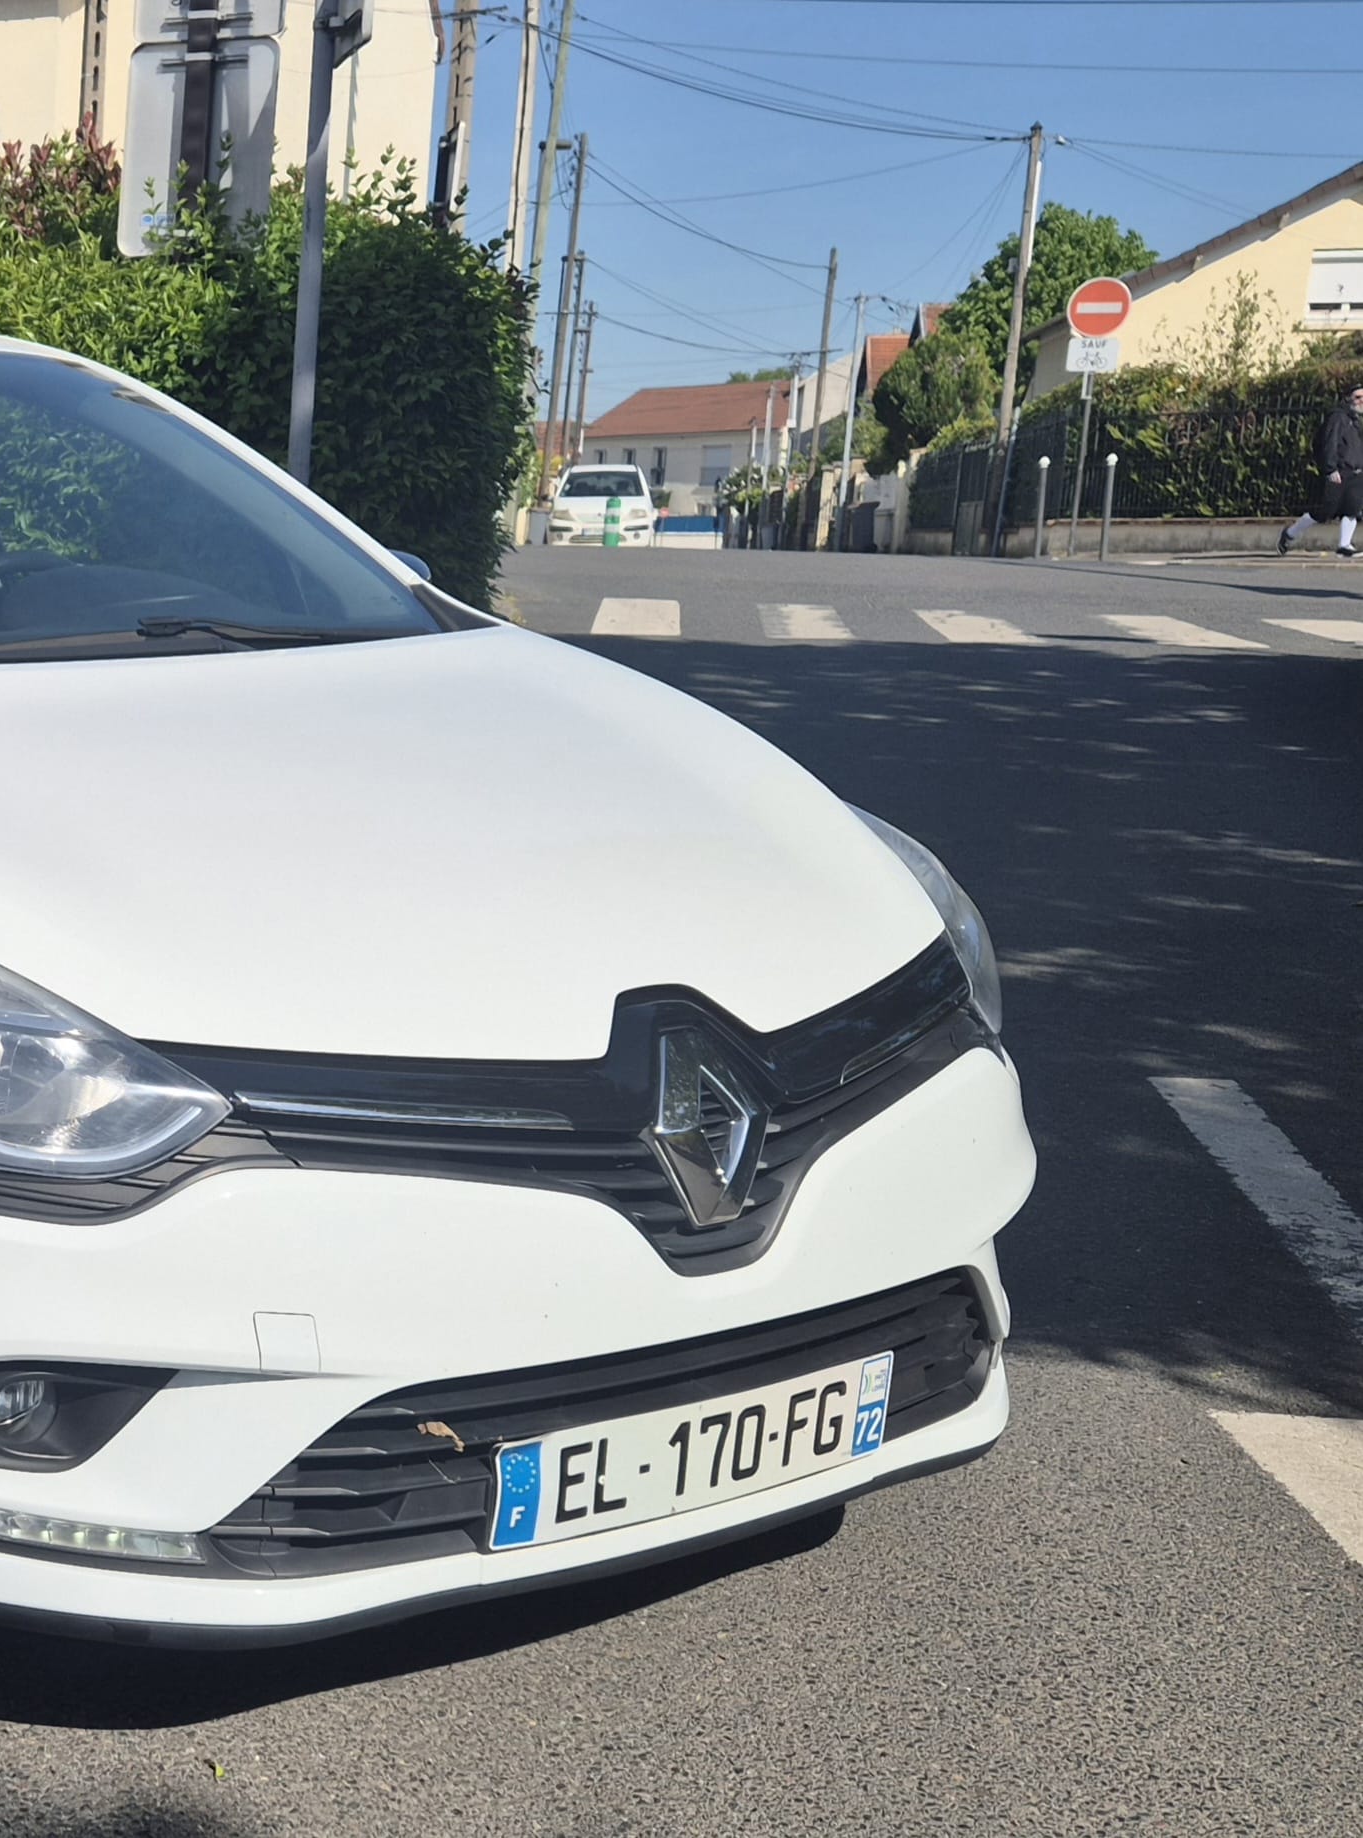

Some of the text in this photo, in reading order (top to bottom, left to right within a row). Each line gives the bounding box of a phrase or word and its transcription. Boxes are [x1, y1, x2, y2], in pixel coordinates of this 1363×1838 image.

[1080, 339, 1107, 349] SAUF
[855, 1406, 882, 1446] 72
[510, 1506, 525, 1528] F
